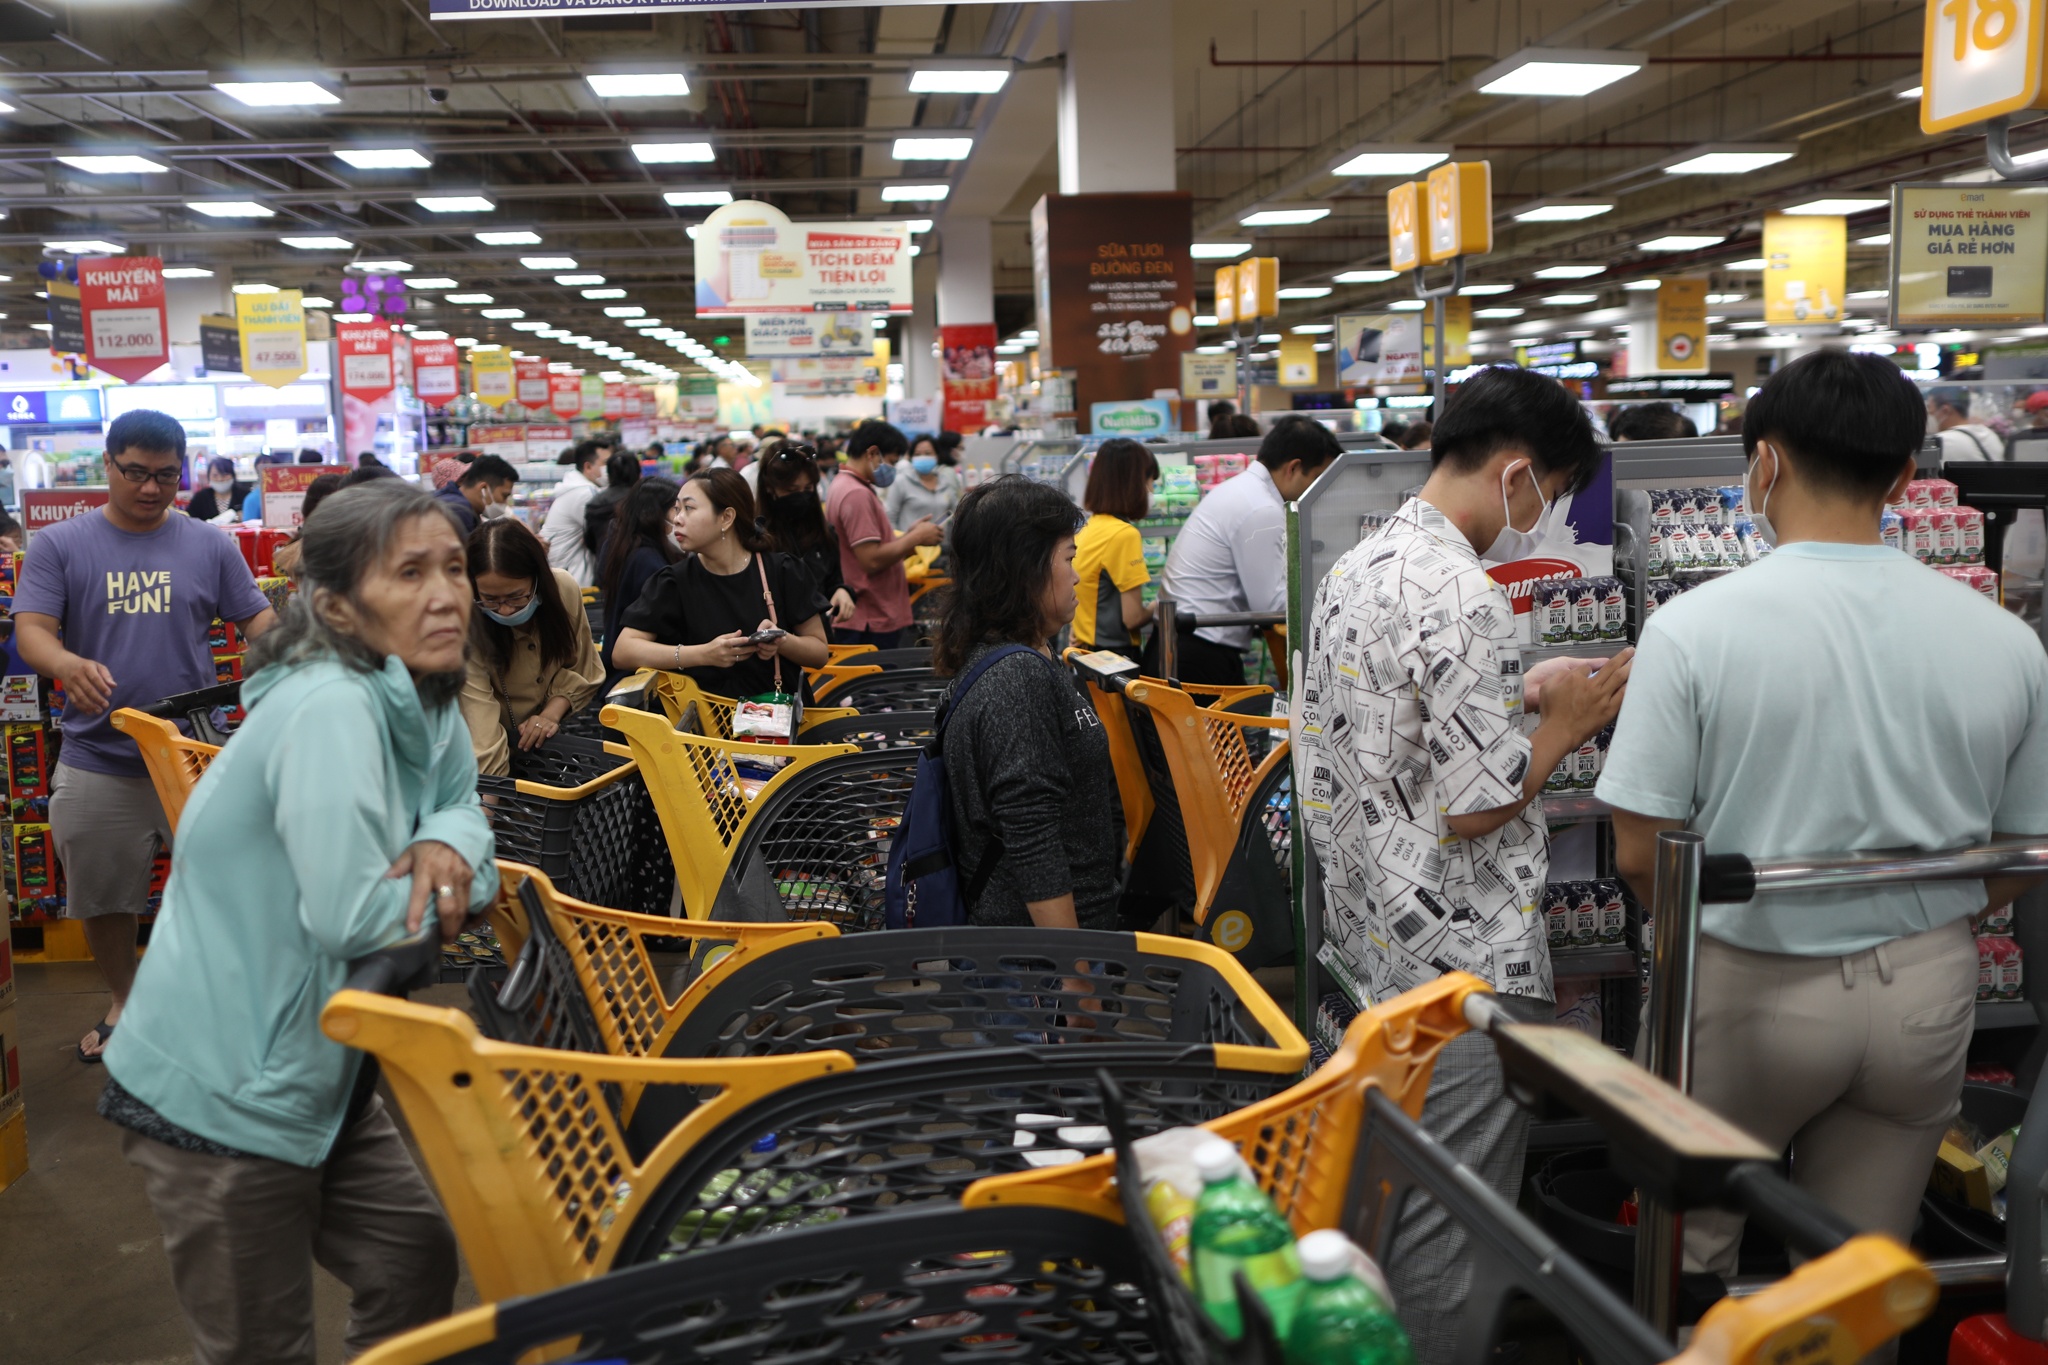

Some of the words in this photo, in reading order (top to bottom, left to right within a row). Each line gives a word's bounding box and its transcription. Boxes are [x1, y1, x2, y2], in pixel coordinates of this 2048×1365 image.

[1943, 0, 2018, 61] 18
[1960, 193, 1985, 202] emart
[1913, 208, 1927, 219] SỬ
[1929, 211, 1954, 220] DỤNG
[1957, 208, 1974, 219] THẺ
[1976, 209, 2008, 219] THÀNH
[2009, 209, 2031, 219] VIÊN
[1928, 224, 1964, 236] MUA
[1969, 221, 2015, 236] HÀNG
[1927, 239, 1954, 254] GIÁ
[1958, 237, 1977, 254] RẺ
[1981, 241, 2015, 254] HƠN
[809, 249, 849, 266] TÍCH
[852, 247, 895, 265] ĐIỂM
[819, 266, 856, 285] TIỆN
[859, 268, 887, 284] LỢI
[1145, 261, 1174, 274] ĐEN
[86, 269, 157, 286] KHUYẾN
[107, 285, 140, 303] MÃI
[98, 334, 153, 348] 112.000
[1103, 413, 1156, 427] NutiMilk
[107, 571, 171, 599] HAVE
[108, 586, 171, 614] FUN!
[1402, 611, 1413, 631] VIP
[1549, 616, 1566, 624] MILK
[1577, 614, 1593, 623] MILK
[1605, 612, 1621, 620] MILK
[1342, 651, 1355, 662] COM
[1437, 668, 1459, 697] HAVE
[1441, 724, 1465, 751] COM
[1429, 738, 1450, 765] WEL
[1555, 764, 1567, 772] ILK
[1578, 762, 1594, 771] MILK
[1380, 790, 1398, 817] COM
[1362, 798, 1381, 826] WEL
[1392, 837, 1407, 857] MAR
[1401, 842, 1416, 861] GILA
[1515, 864, 1534, 880] WEL
[1549, 922, 1566, 930] MILK
[1578, 920, 1594, 928] MILK
[1604, 918, 1621, 926] MILK
[1400, 955, 1418, 971] VIP
[1443, 951, 1471, 971] HAVE
[1505, 961, 1531, 977] WEL
[1506, 985, 1535, 996] COM
